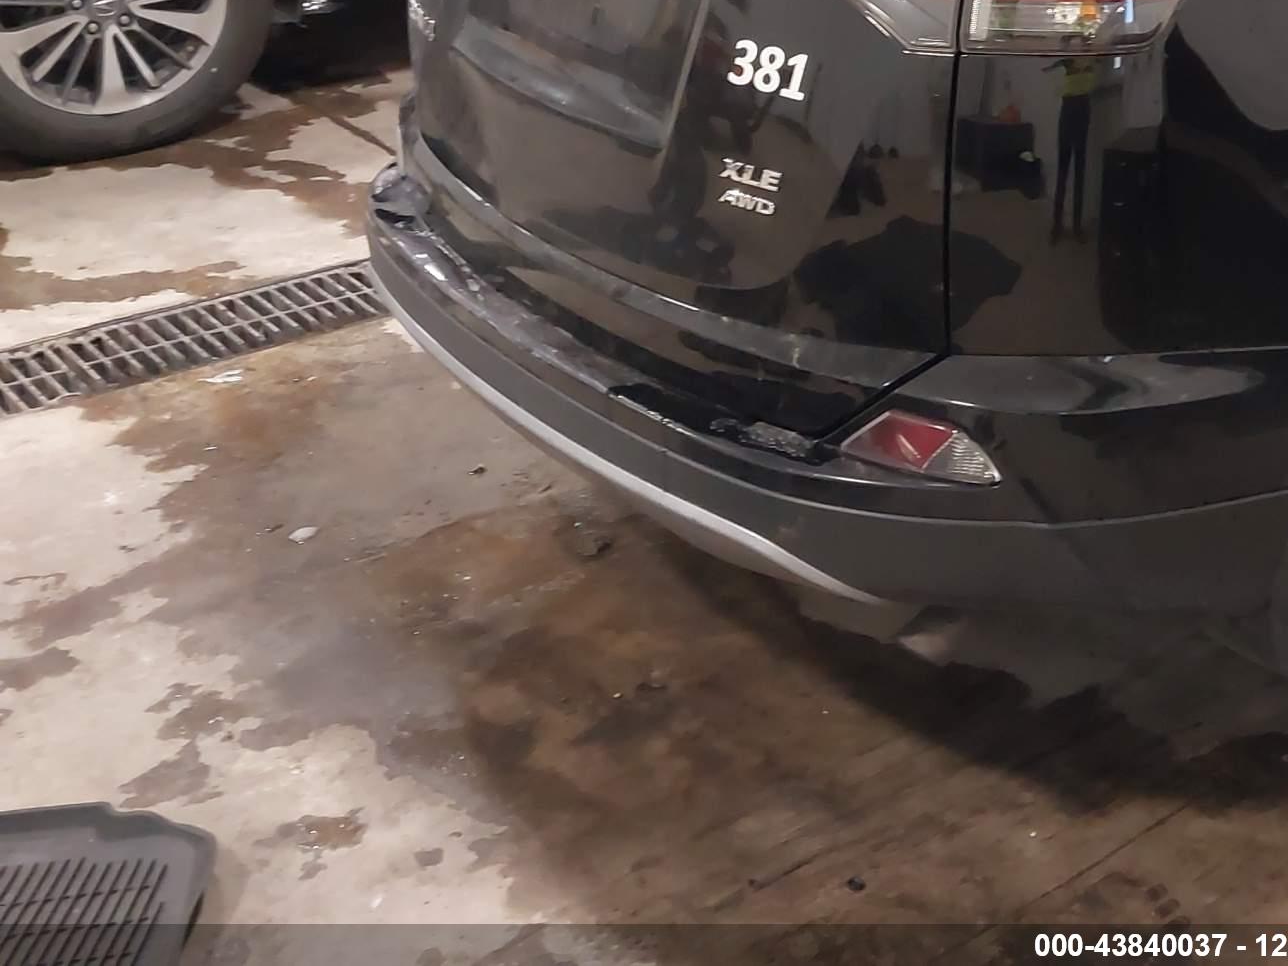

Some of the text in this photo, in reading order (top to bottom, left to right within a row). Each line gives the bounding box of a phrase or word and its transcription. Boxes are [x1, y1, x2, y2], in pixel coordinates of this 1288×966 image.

[727, 39, 809, 101] 381
[718, 158, 783, 192] XLE
[718, 188, 776, 215] AWD
